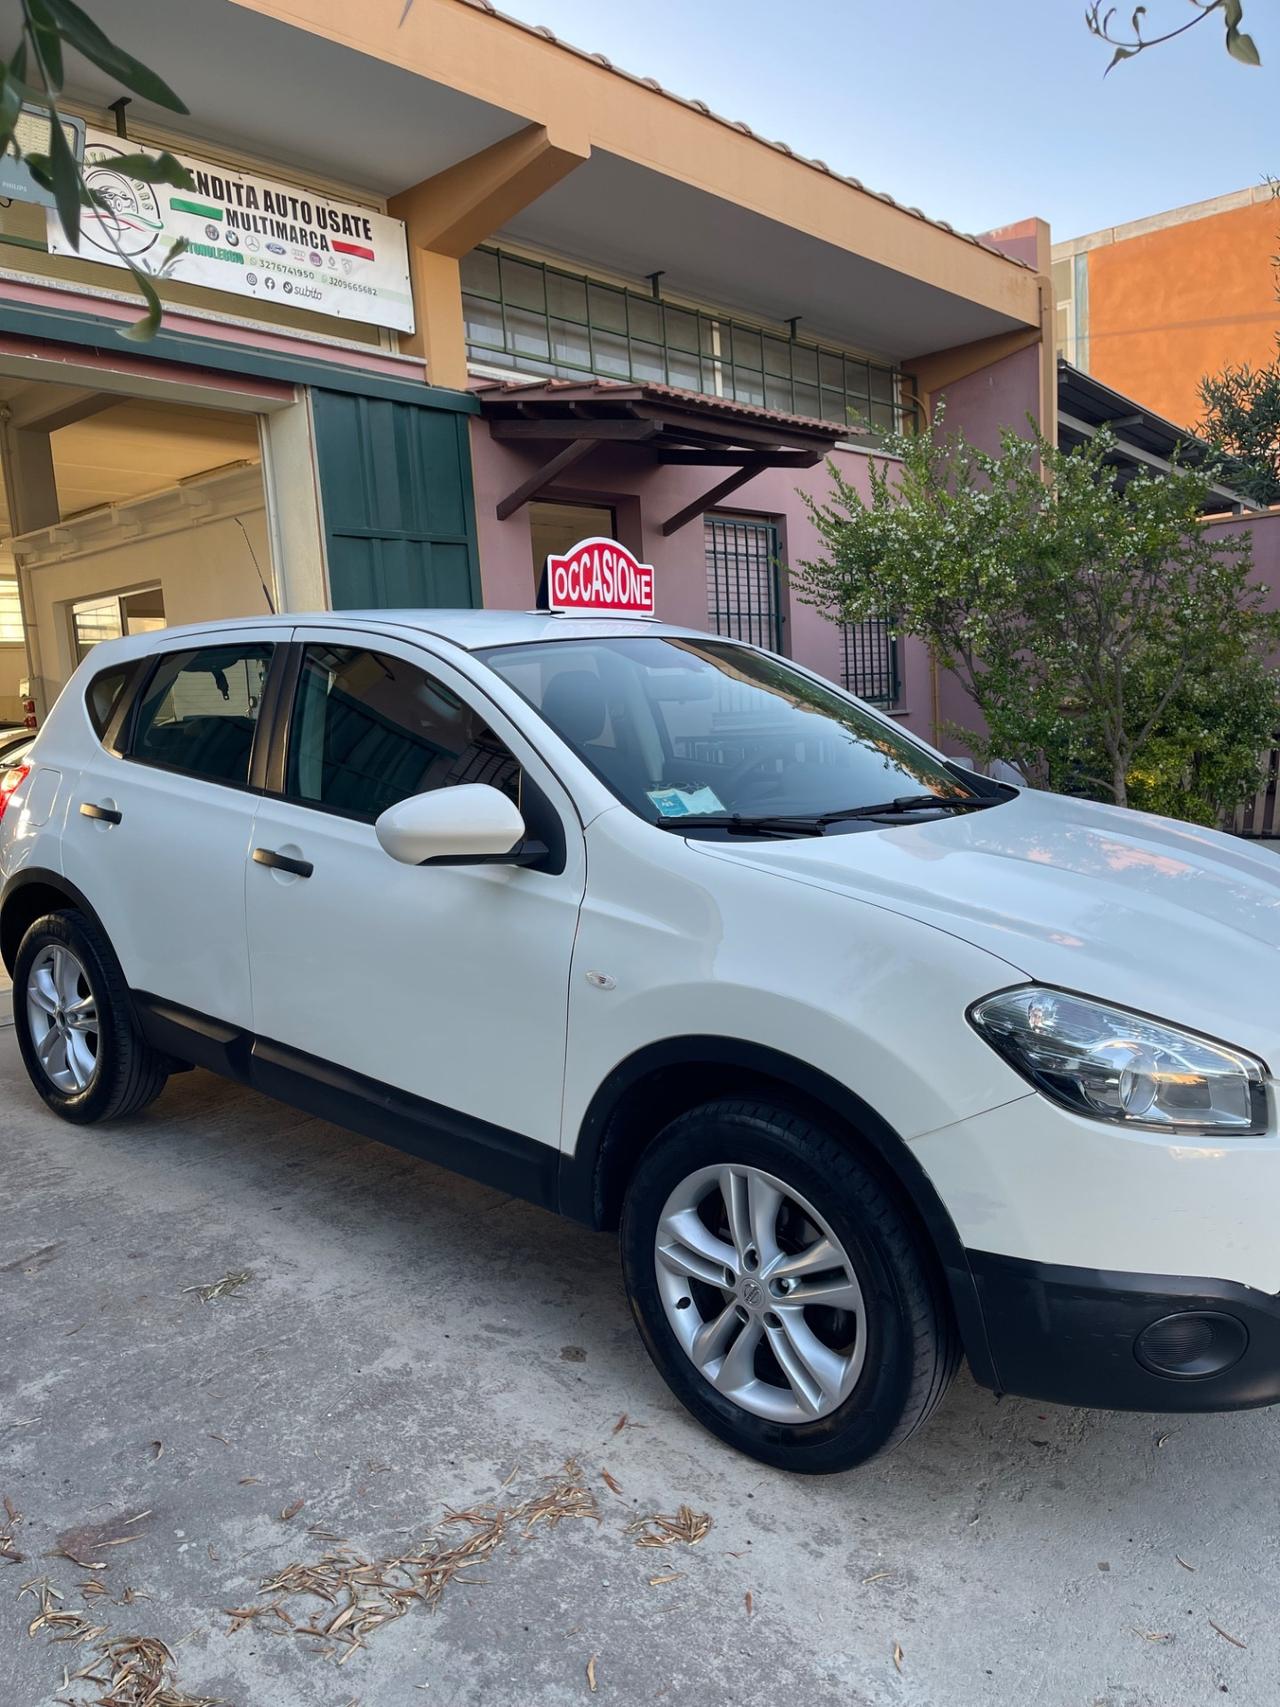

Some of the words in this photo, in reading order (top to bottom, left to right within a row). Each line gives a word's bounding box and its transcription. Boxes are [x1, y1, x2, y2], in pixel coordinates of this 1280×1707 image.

[185, 167, 260, 210] NDITA
[262, 189, 313, 225] AUTO
[315, 205, 373, 241] USATE
[225, 207, 331, 252] MULTIMARCA
[258, 259, 315, 280] 3276741950
[328, 276, 378, 296] 3209665682
[293, 284, 323, 301] subito
[554, 549, 651, 605] OCCASIONE
